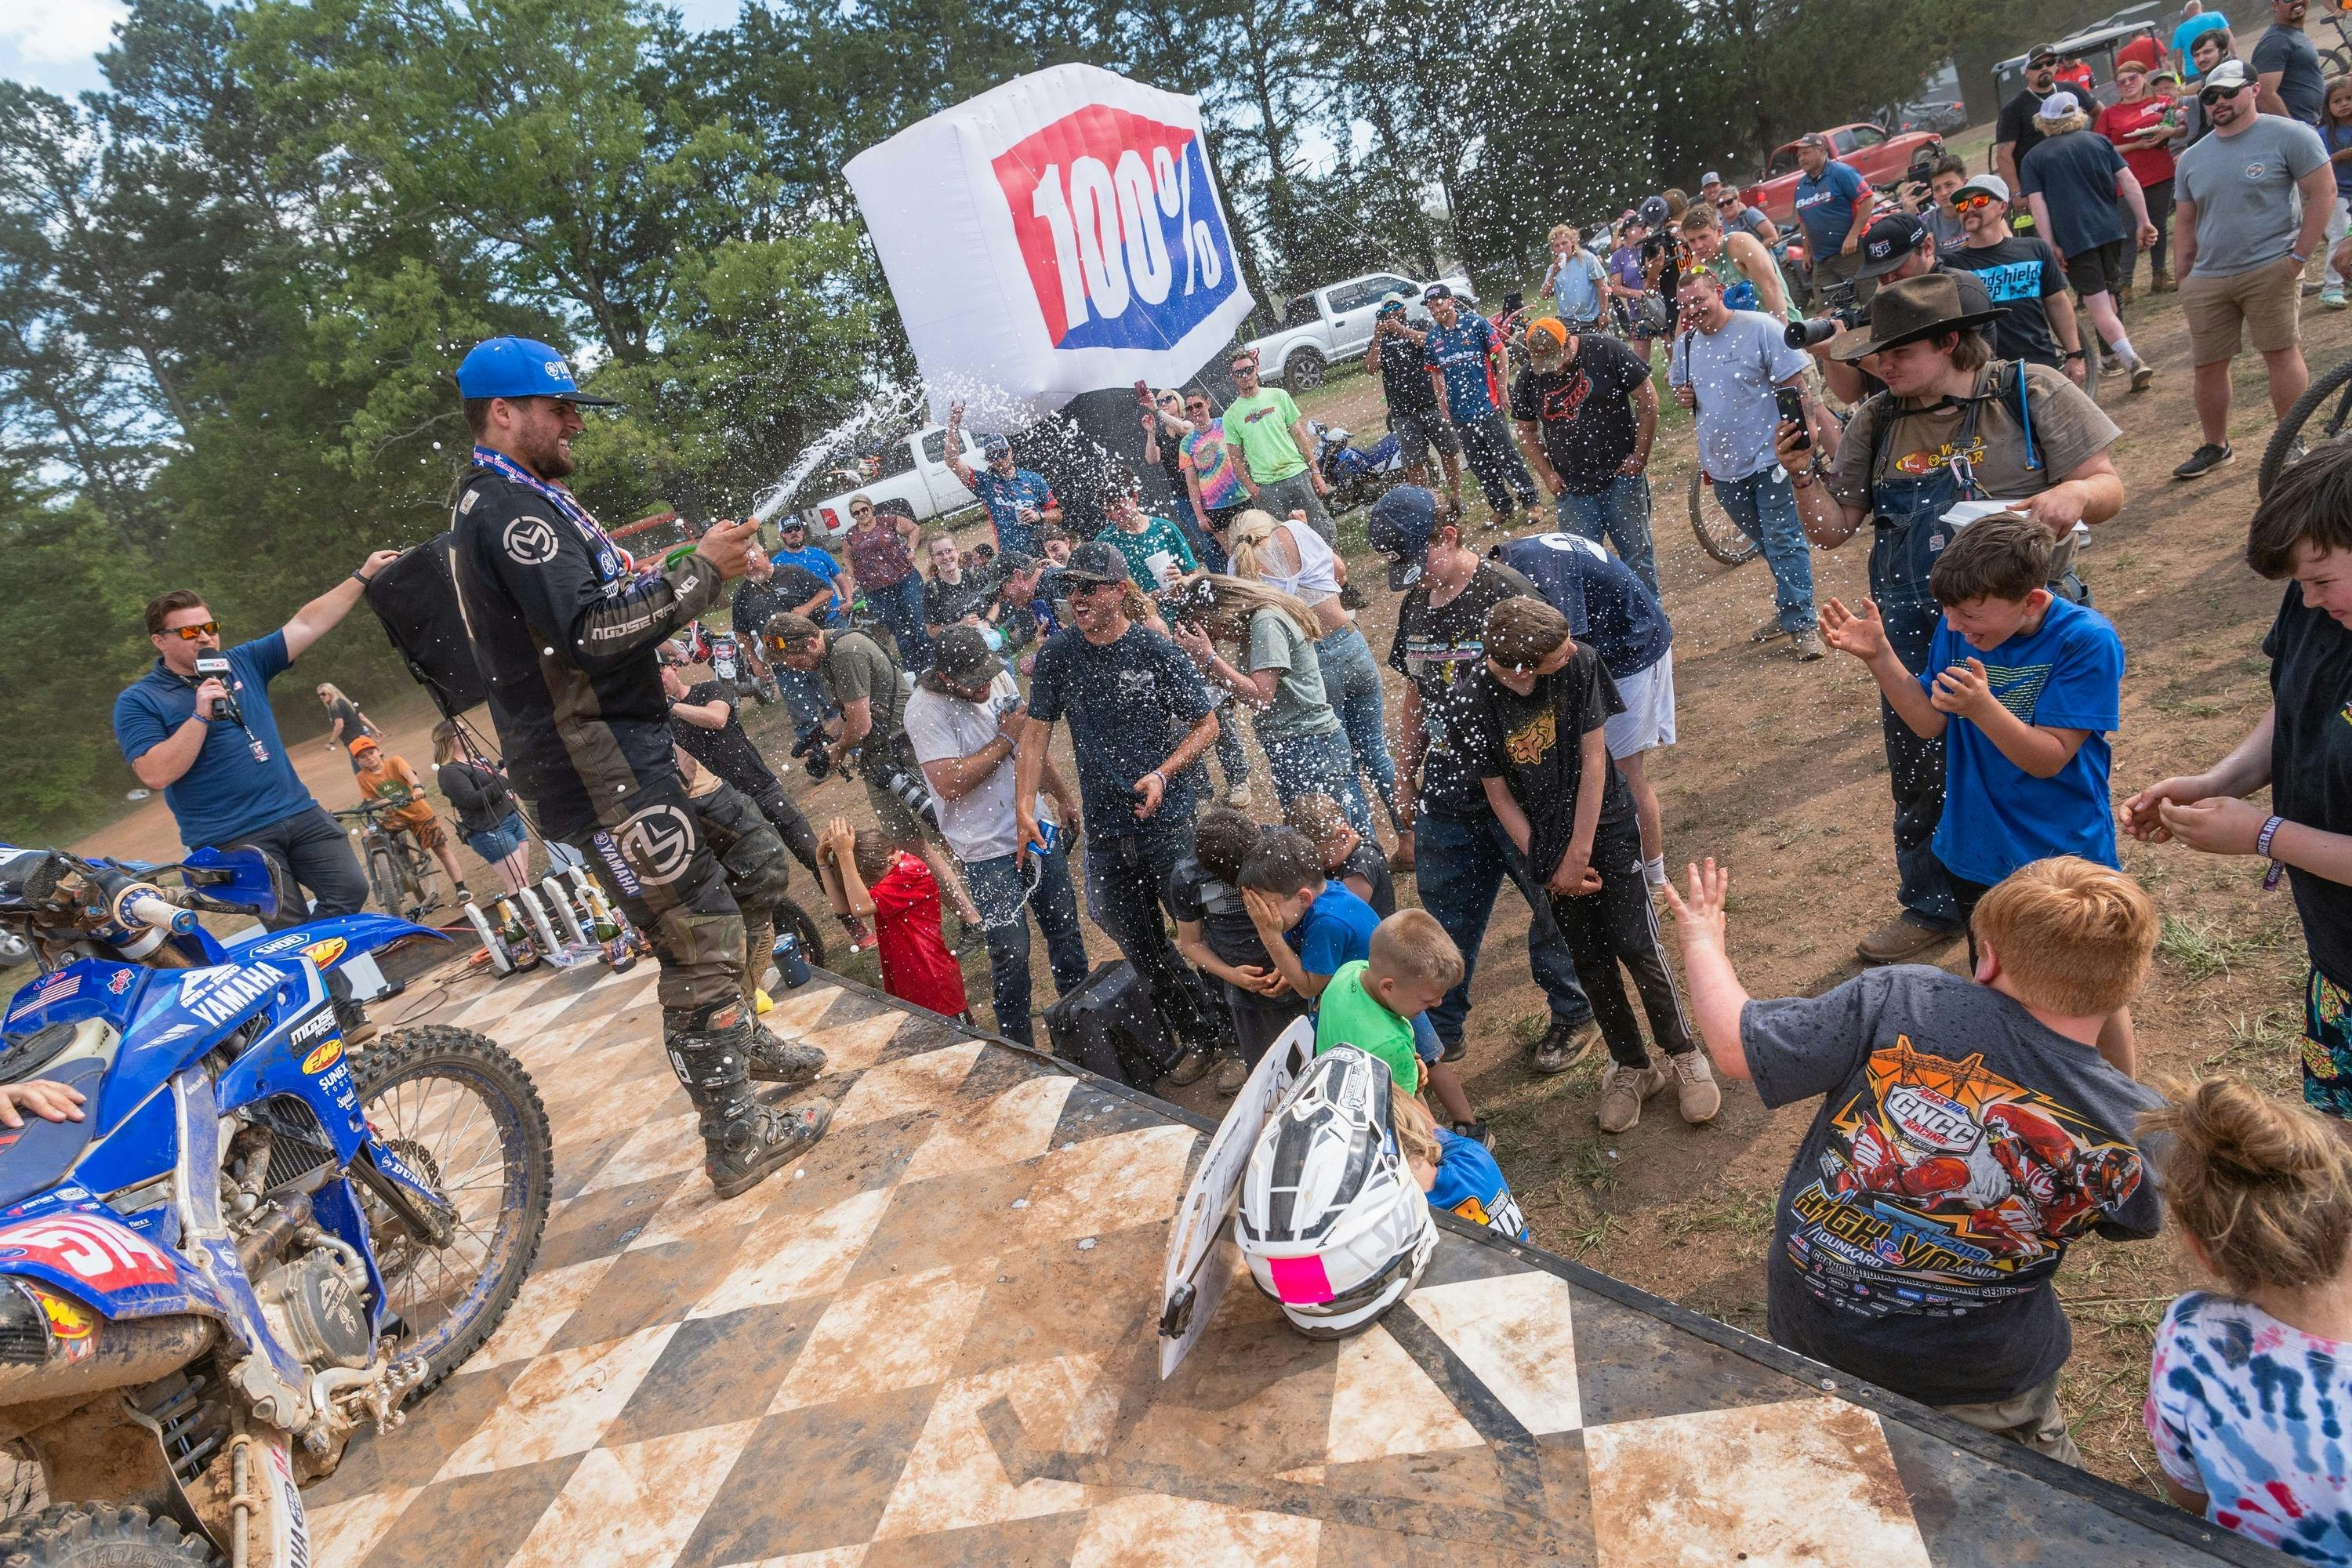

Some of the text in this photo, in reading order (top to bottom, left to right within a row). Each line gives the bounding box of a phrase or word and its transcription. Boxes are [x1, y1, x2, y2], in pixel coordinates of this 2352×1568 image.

[1796, 192, 1831, 209] Beta
[1032, 146, 1221, 329] 100%
[494, 459, 517, 475] GRAND
[601, 844, 639, 894] YAMAHA
[256, 935, 305, 955] SHOEI
[112, 969, 131, 993] IMS
[189, 961, 287, 1029] YAMAHA
[290, 1005, 334, 1046] MOOSE
[315, 1018, 336, 1040] RACING
[303, 1039, 343, 1075] FMF
[318, 1064, 349, 1091] SUNEX
[325, 1073, 353, 1097] TOOLS
[1890, 1092, 1976, 1143] GNCC
[1915, 1087, 1968, 1116] AMSOIL
[1903, 1119, 1949, 1145] RACING
[392, 1163, 441, 1200] DUNLO
[129, 1217, 151, 1229] flexx
[1794, 1184, 1893, 1252] HIGH
[1818, 1232, 1884, 1269] DUNKARD
[1812, 1250, 1845, 1273] GRAND
[1846, 1265, 1896, 1283] NATIONAL
[1982, 1287, 2016, 1297] SERIES
